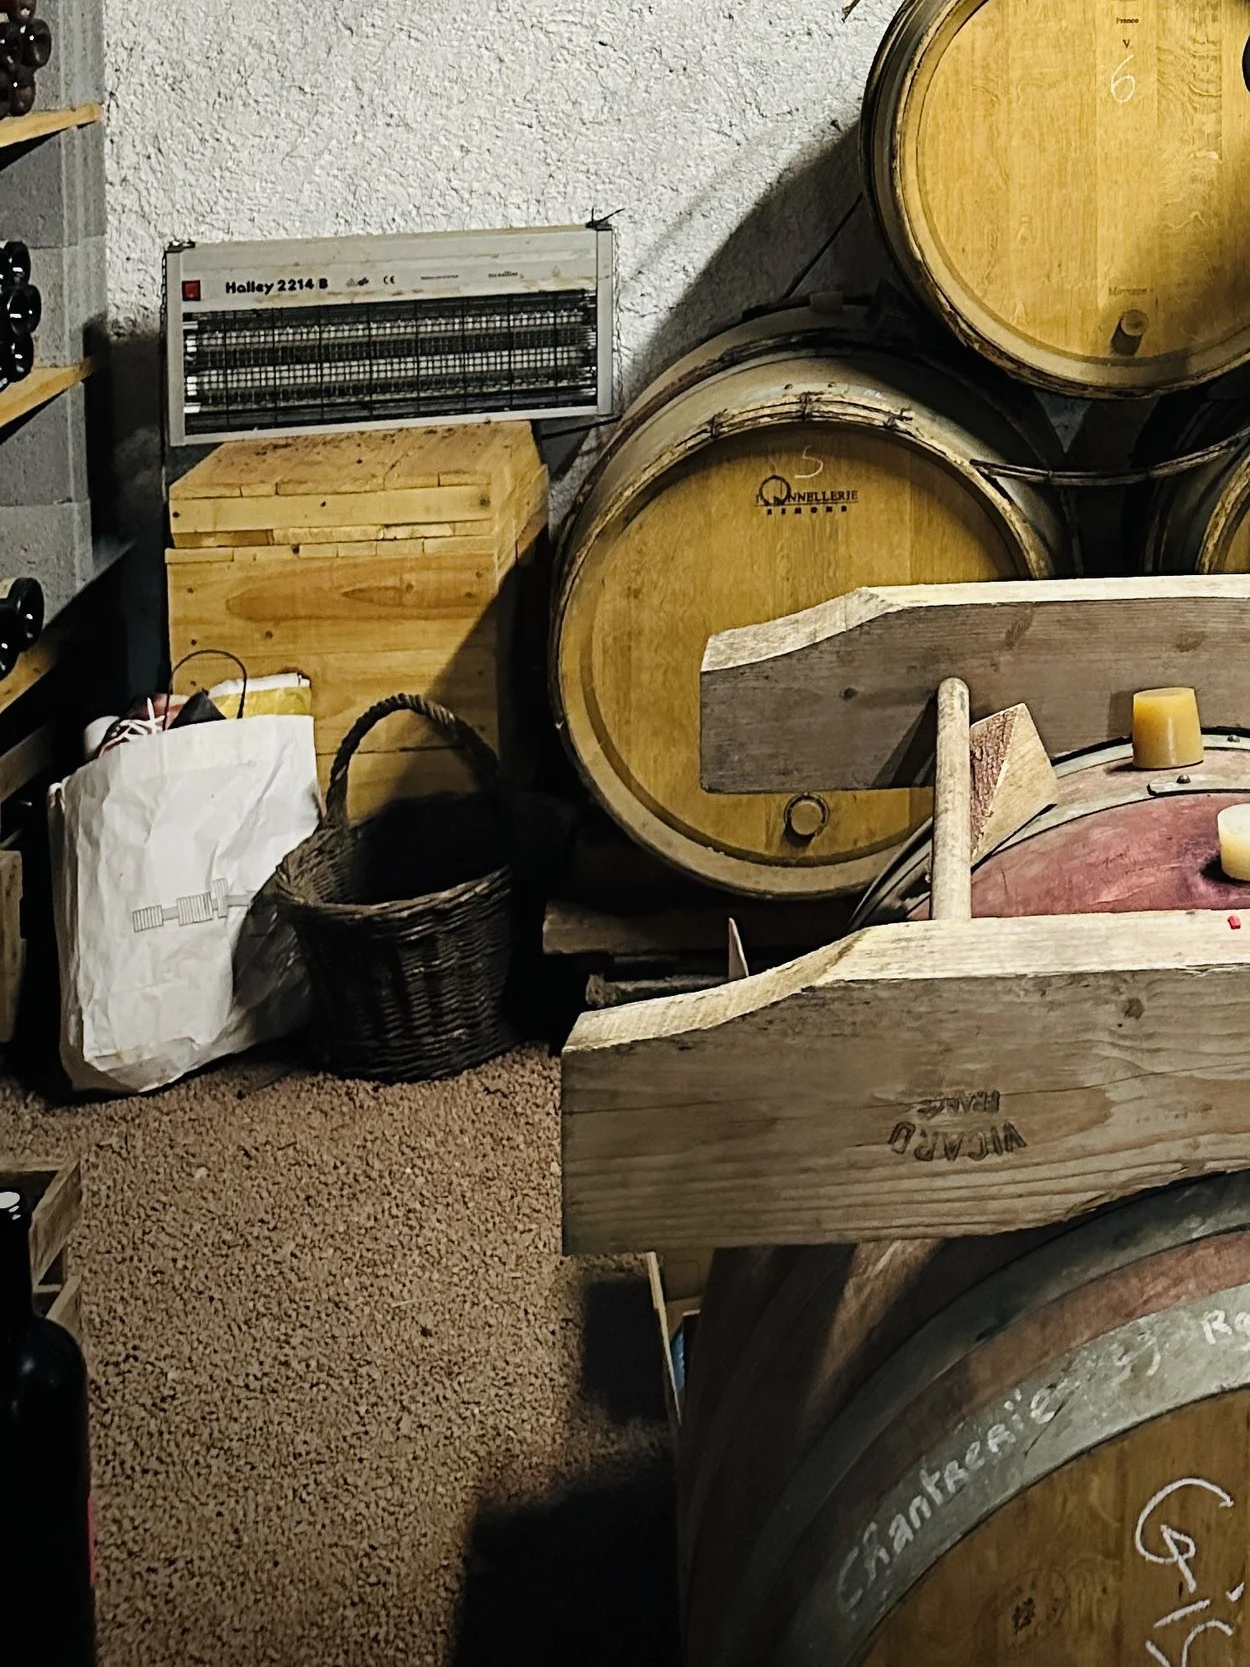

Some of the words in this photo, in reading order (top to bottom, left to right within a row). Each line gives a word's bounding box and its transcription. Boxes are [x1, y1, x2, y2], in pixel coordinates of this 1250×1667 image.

[1110, 54, 1136, 103] 6
[225, 278, 275, 295] Halley
[277, 278, 314, 292] 2214
[318, 278, 329, 290] B
